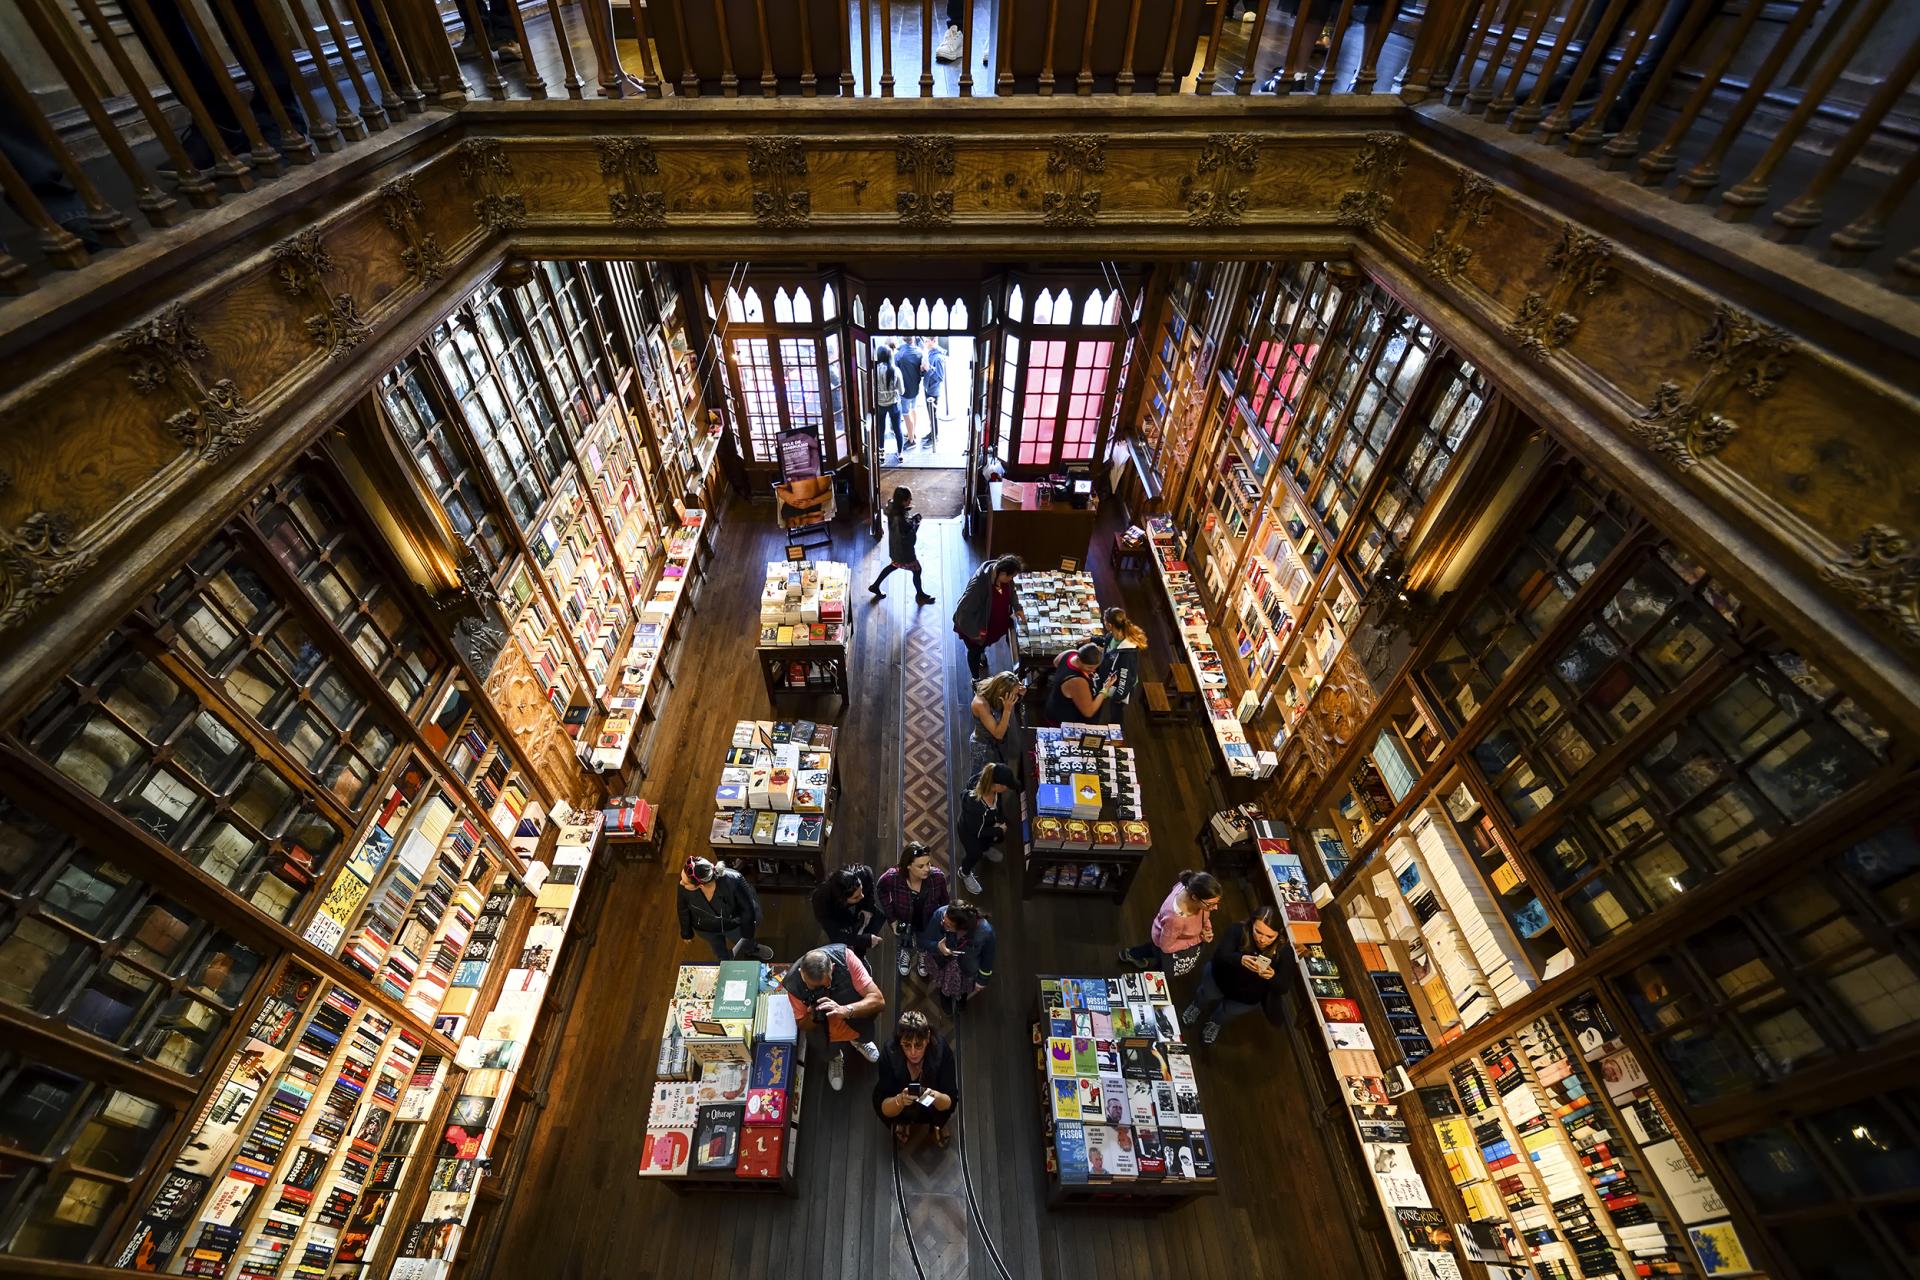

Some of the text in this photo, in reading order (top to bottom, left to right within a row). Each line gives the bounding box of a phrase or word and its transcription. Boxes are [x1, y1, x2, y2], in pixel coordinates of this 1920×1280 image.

[152, 1175, 187, 1219] KING
[1398, 1211, 1420, 1221] KING
[1421, 1214, 1443, 1222] KING
[405, 1223, 422, 1255] SPARK
